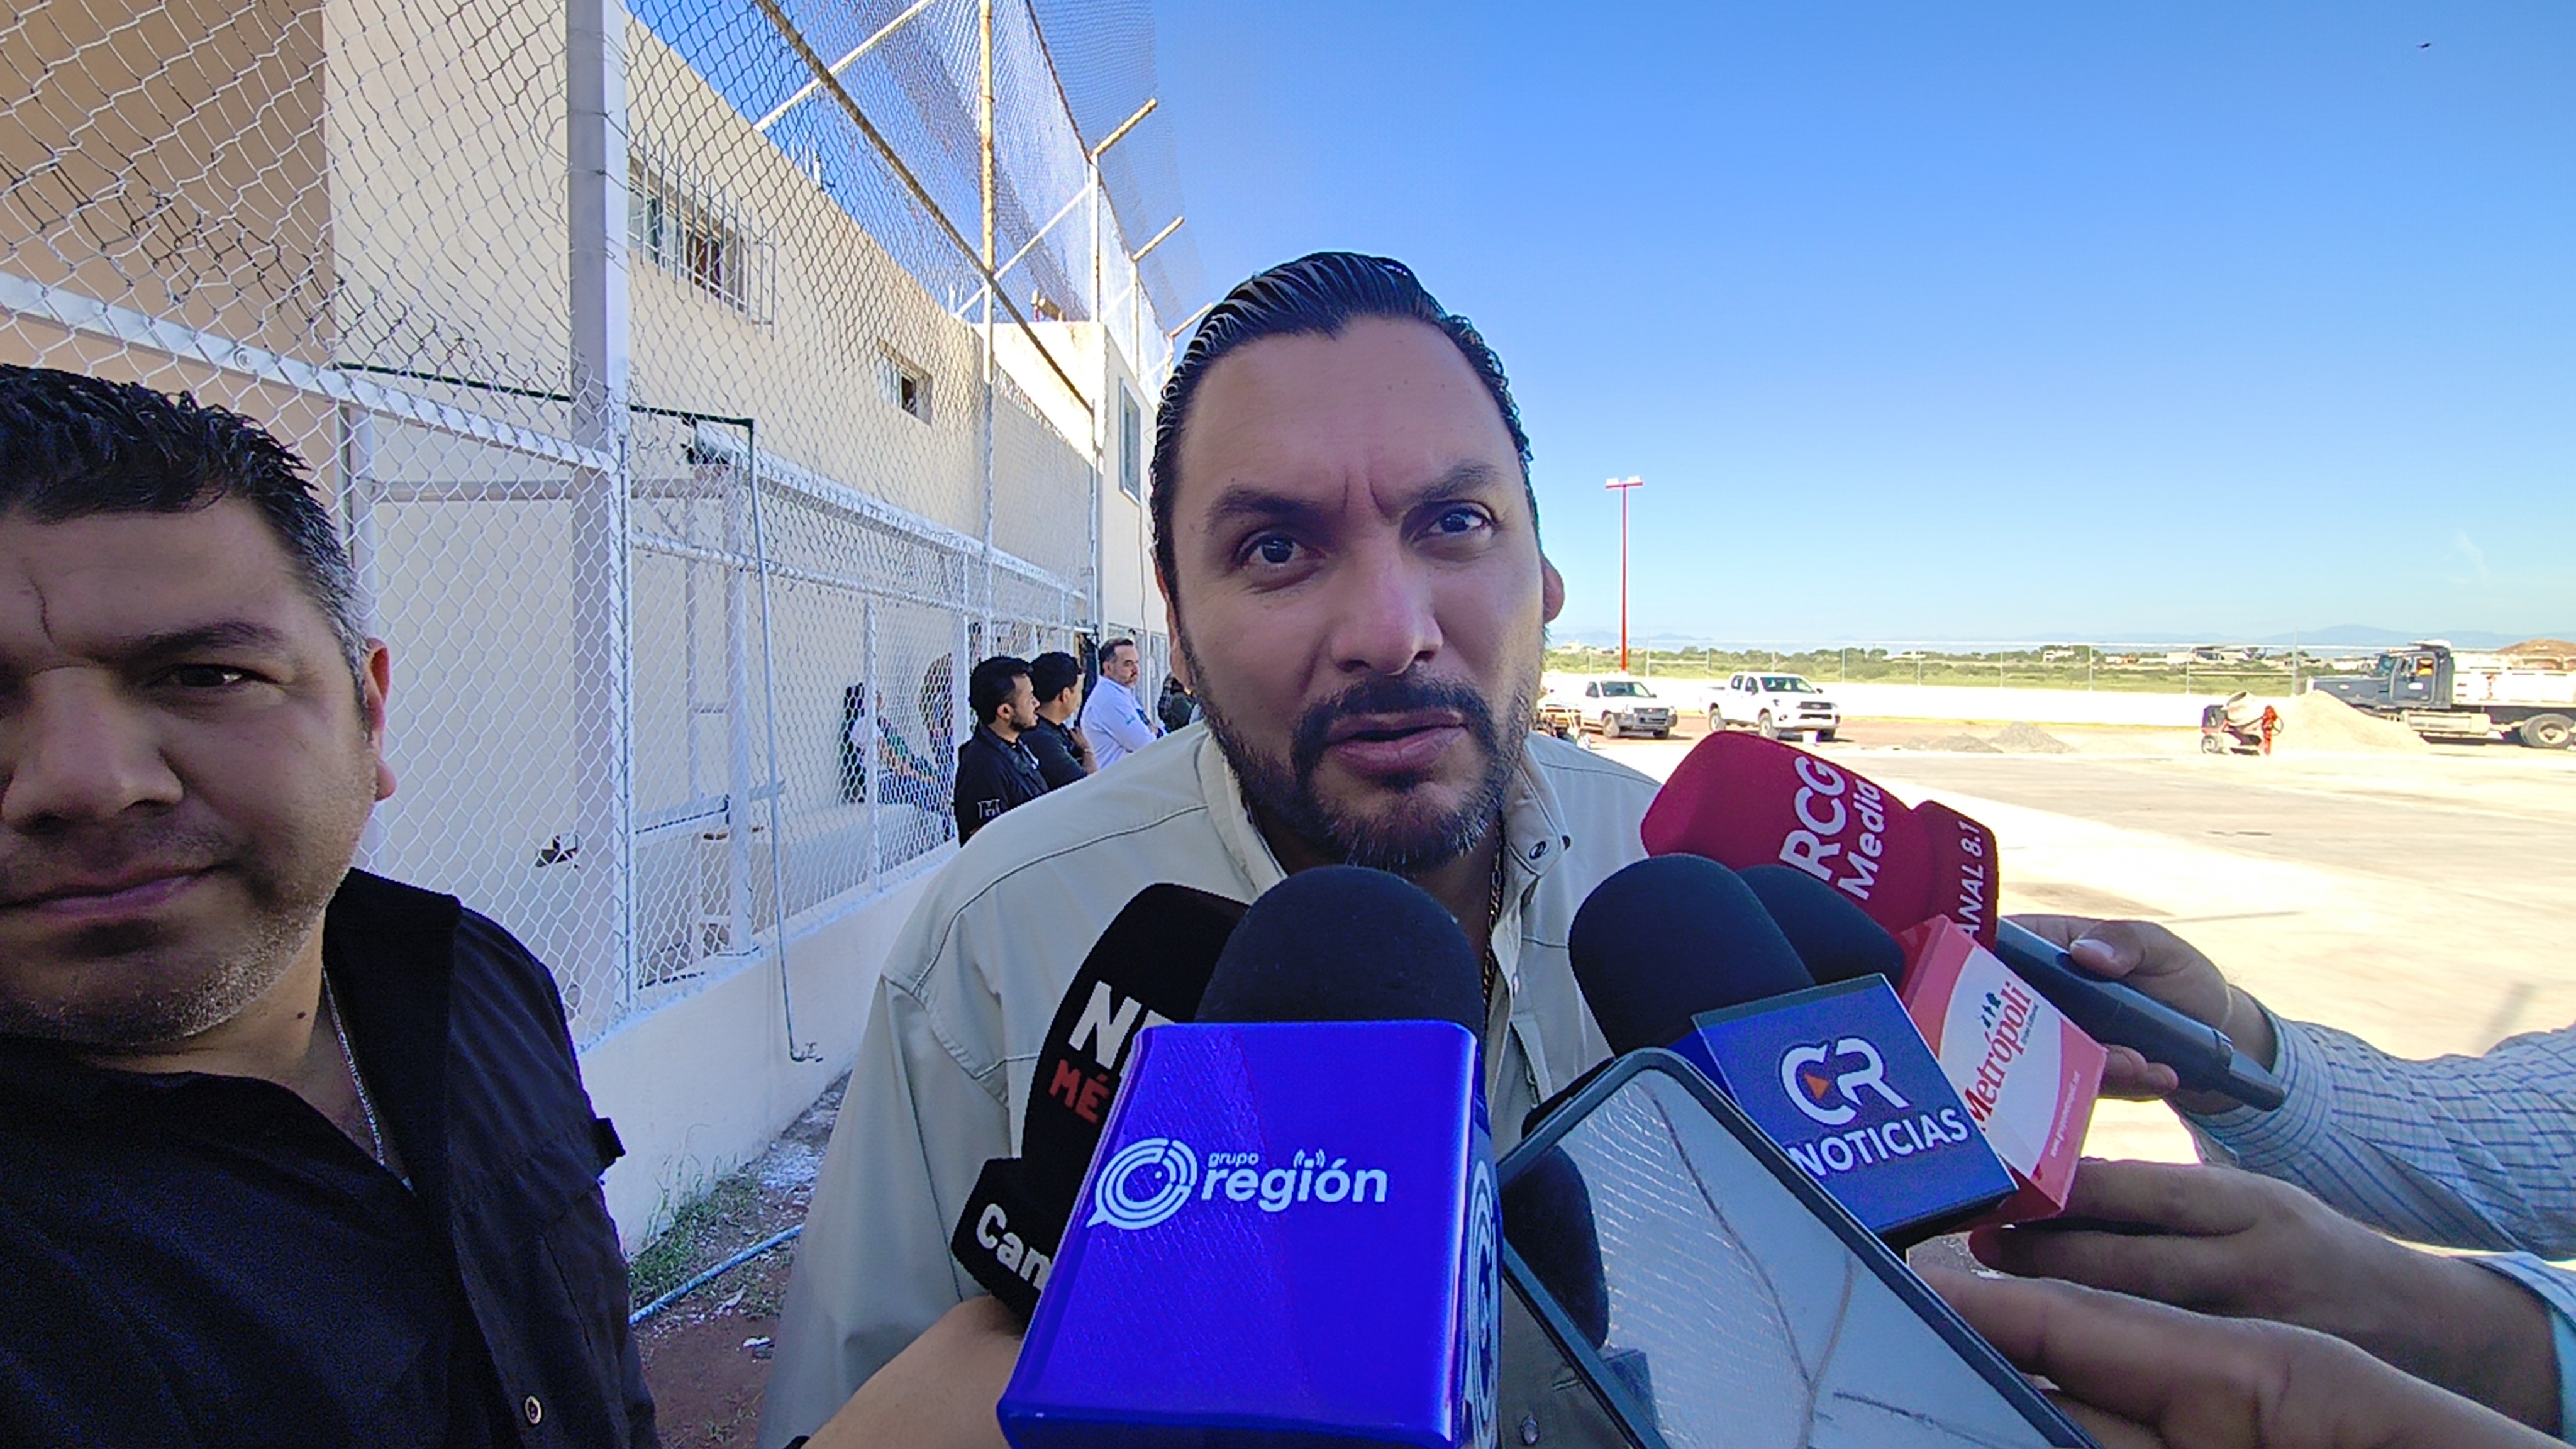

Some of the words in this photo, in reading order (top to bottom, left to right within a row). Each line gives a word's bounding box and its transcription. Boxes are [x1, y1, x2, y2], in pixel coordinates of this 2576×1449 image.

[1779, 756, 1846, 881] RCG
[1837, 779, 1884, 900] Media
[1958, 820, 1982, 857] 8.1
[1068, 980, 1175, 1070] N
[1965, 980, 2031, 1132] Metrópoli
[1781, 1038, 1910, 1125] CR
[1201, 1158, 1387, 1213] región
[1208, 1152, 1259, 1167] grupo
[1788, 1108, 1968, 1177] NOTICIAS
